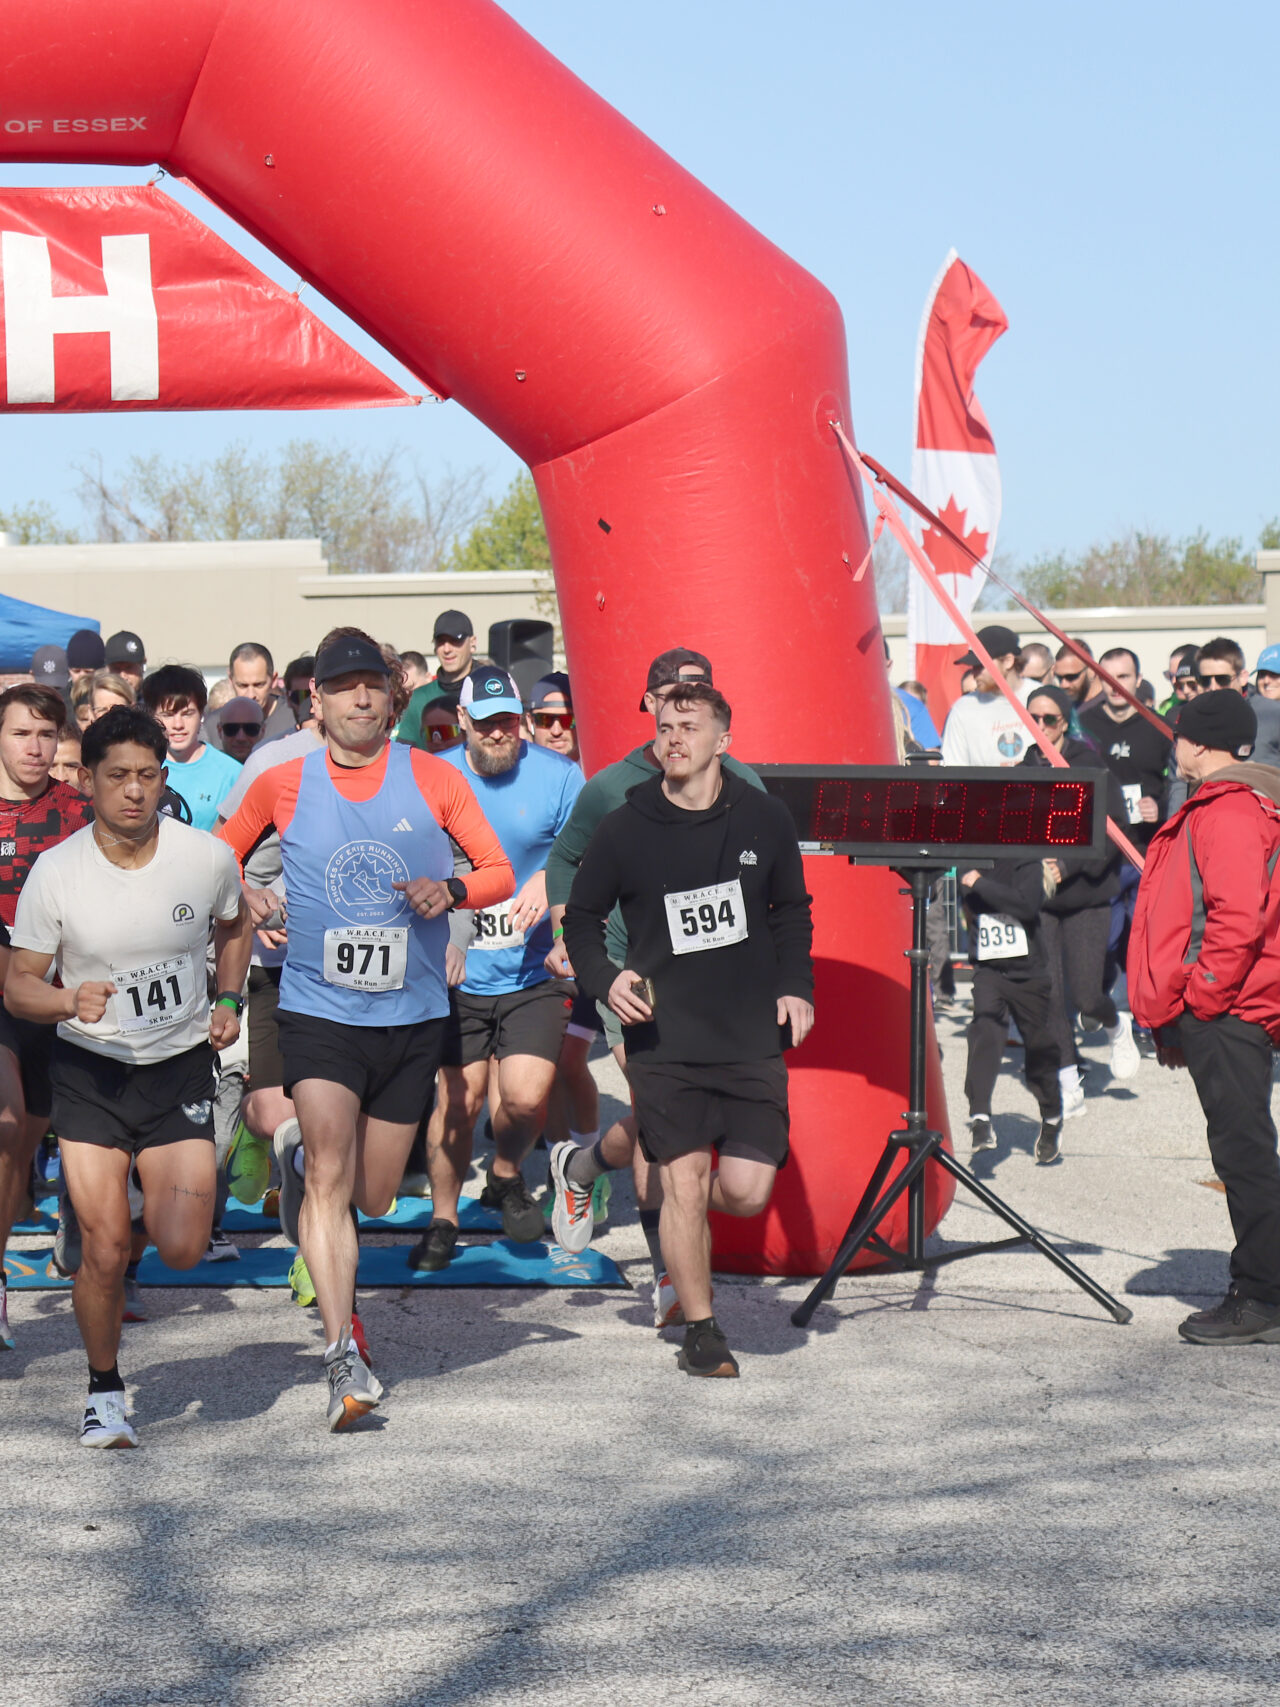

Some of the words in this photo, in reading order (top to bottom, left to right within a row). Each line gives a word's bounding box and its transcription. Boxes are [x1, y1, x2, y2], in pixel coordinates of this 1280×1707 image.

[4, 119, 43, 133] OF
[53, 117, 147, 132] ESSEX
[336, 854, 344, 866] OF
[346, 845, 366, 855] ERIE
[368, 845, 403, 874] RUNNING
[680, 899, 736, 937] 594
[980, 923, 1016, 947] 939
[337, 942, 390, 976] 971
[126, 974, 182, 1017] 141
[148, 1017, 158, 1026] 5K
[160, 1014, 173, 1023] Run
